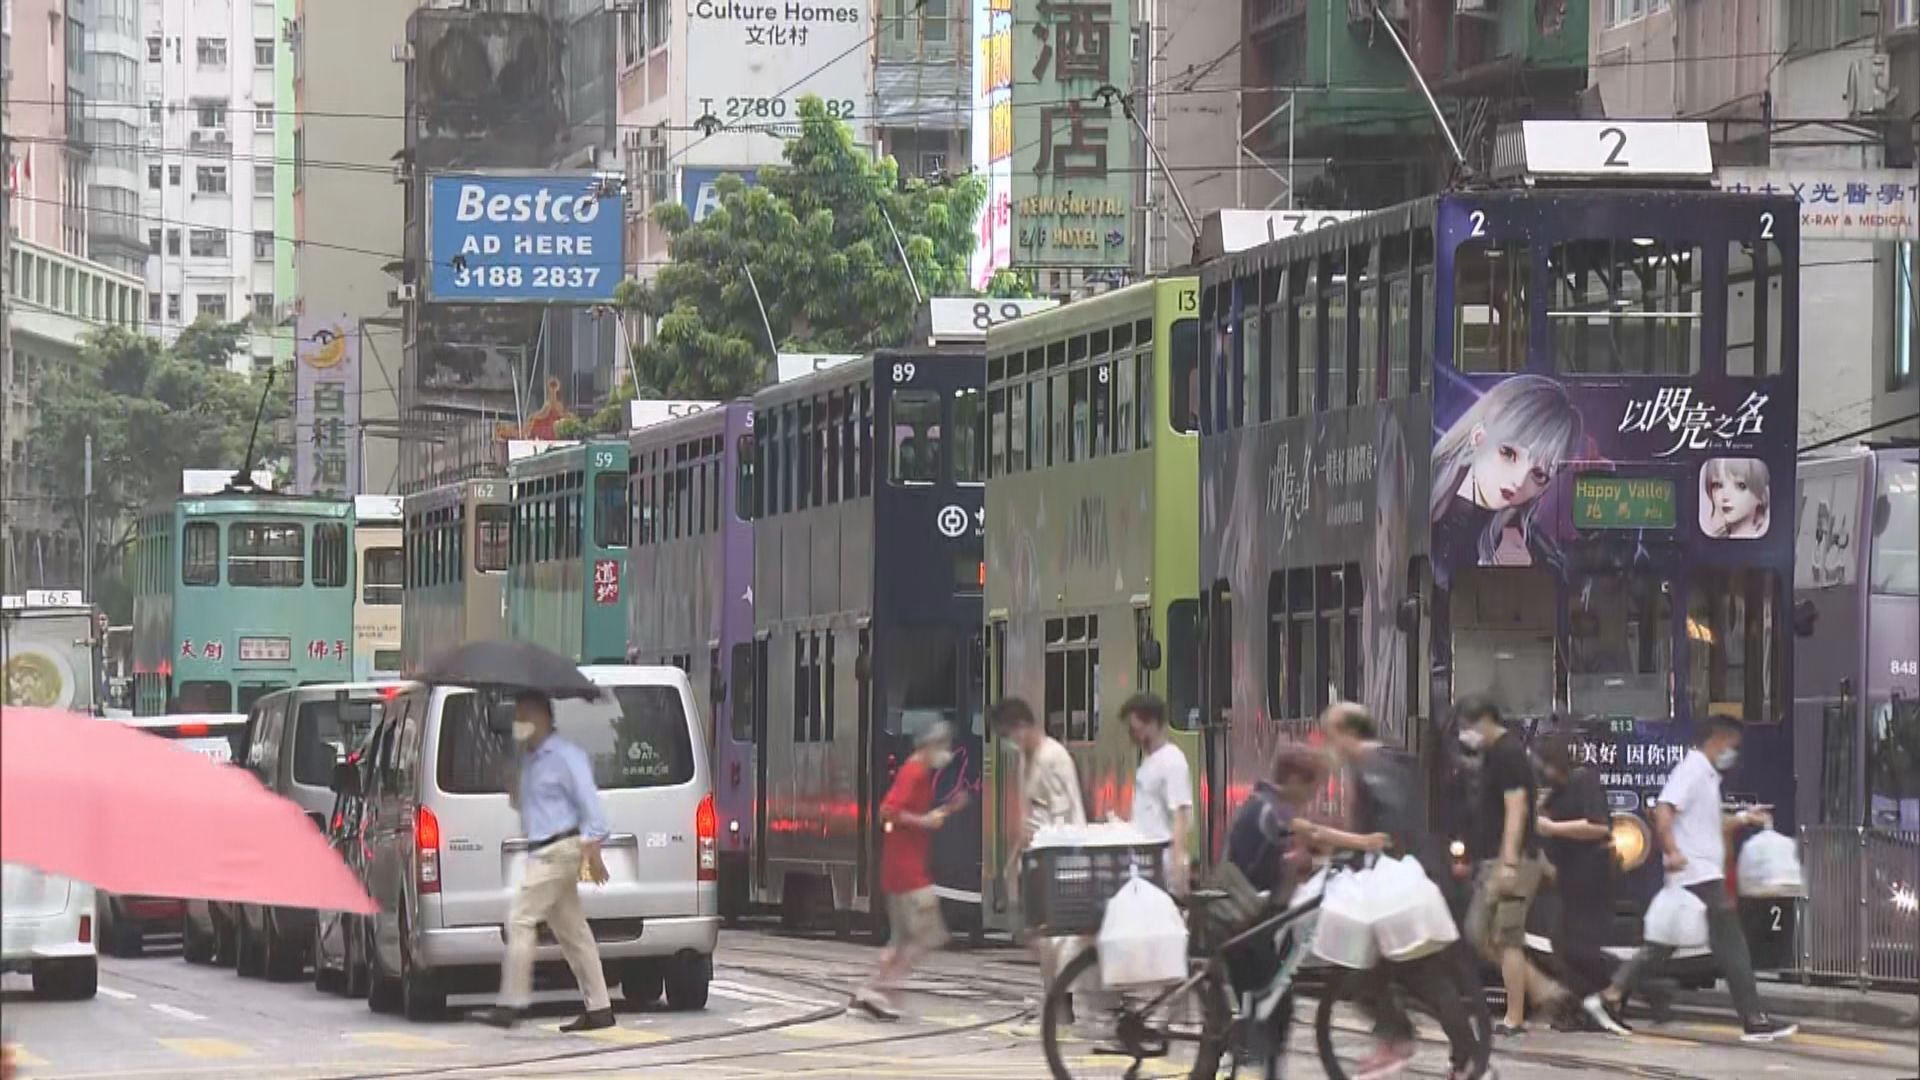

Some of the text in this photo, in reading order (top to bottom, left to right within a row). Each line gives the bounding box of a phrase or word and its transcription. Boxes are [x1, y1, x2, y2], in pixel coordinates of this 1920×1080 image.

[697, 1, 859, 23] Culture Homes
[745, 25, 808, 46] 文化村
[1032, 2, 1112, 179] 酒店
[726, 97, 787, 118] 2780
[1600, 128, 1629, 167] 2
[456, 184, 599, 223] Bestco
[1019, 197, 1124, 218] NEW CAPITAL
[1470, 211, 1485, 236] 2
[1760, 212, 1774, 239] 2
[1802, 215, 1838, 225] X-RAY
[1859, 214, 1912, 227] MEDICAL
[461, 235, 593, 255] AD HERE
[1053, 228, 1098, 248] HOTEL
[454, 266, 601, 288] 3188 2837
[892, 364, 915, 382] 89
[1618, 387, 1769, 458] 以閃亮之名
[594, 452, 613, 468] 59
[474, 484, 494, 498] 162
[1576, 481, 1671, 501] Happy Valley
[41, 592, 70, 605] 165
[1891, 660, 1918, 675] 848
[1770, 905, 1782, 931] 2
